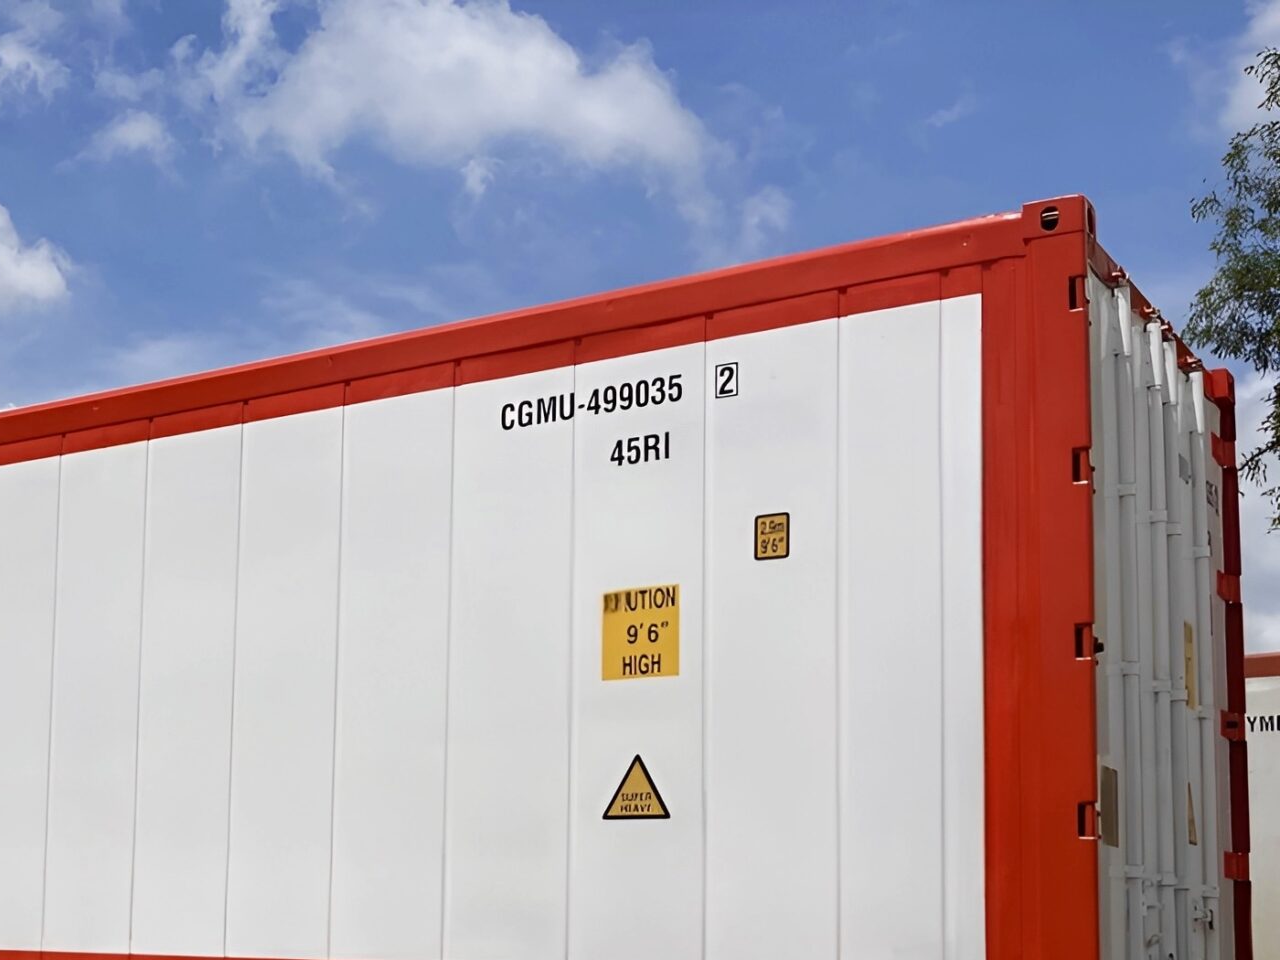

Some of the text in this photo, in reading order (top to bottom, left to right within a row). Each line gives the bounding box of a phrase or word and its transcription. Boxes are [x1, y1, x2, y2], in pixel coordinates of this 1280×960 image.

[501, 366, 735, 431] CGMU-499035 2
[622, 653, 661, 676] HIGH
